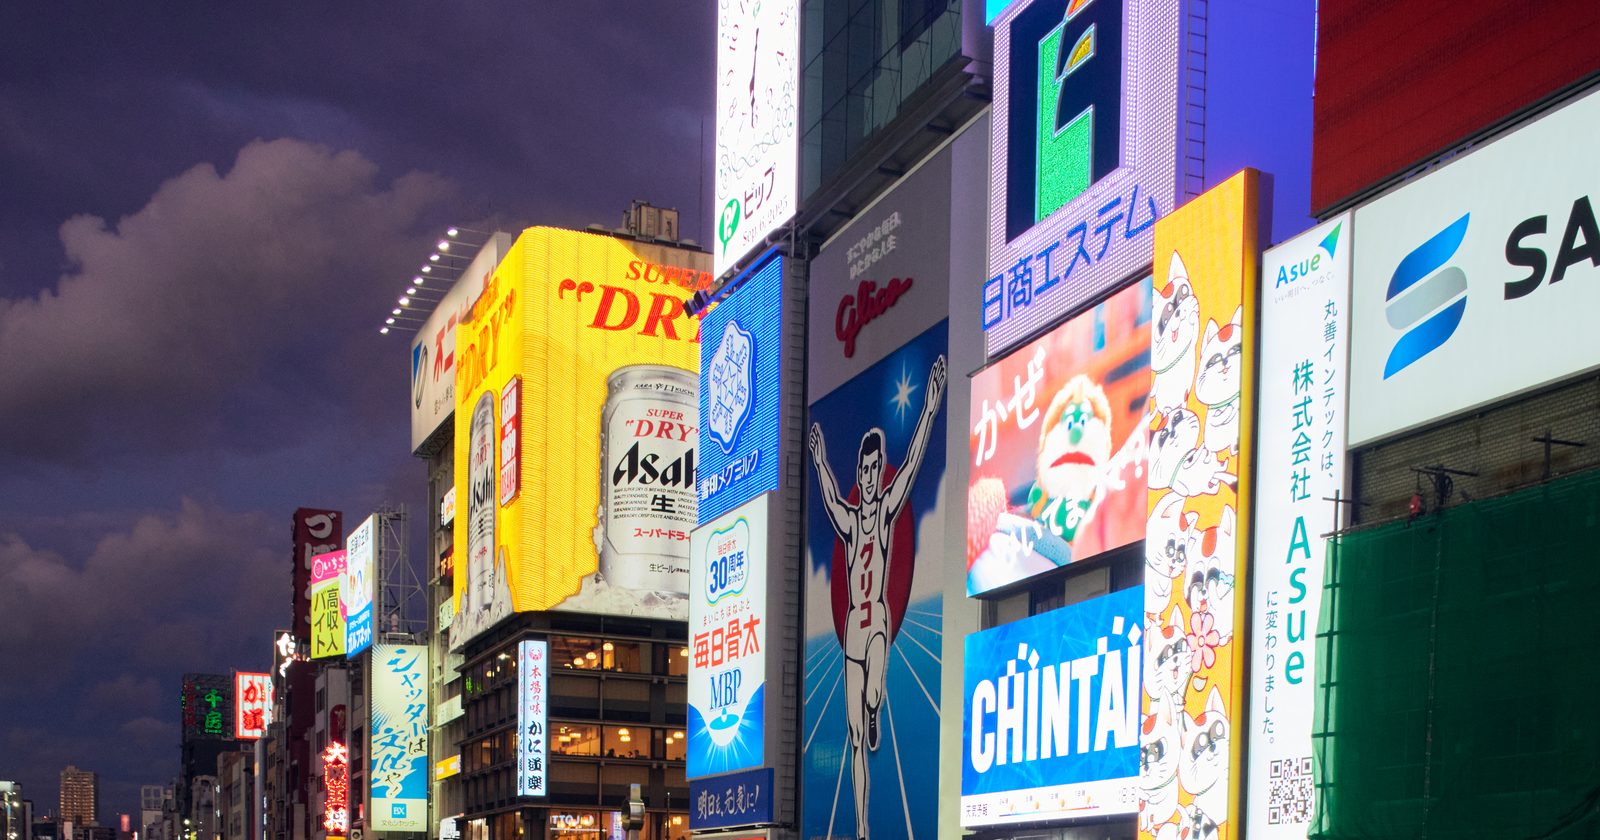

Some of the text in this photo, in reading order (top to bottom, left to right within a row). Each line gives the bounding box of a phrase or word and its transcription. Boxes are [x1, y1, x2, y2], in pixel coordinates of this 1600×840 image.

[982, 184, 1157, 332] 日商エステム
[1276, 254, 1321, 289] Asue
[836, 278, 913, 358] Glico
[646, 408, 684, 421] SUPER
[974, 346, 1047, 468] かぜ
[1320, 299, 1339, 479] 丸善インテックは、
[651, 494, 675, 514] 生
[701, 448, 759, 501] 雪印メグミルク
[709, 550, 744, 594] 30周年
[859, 537, 875, 630] グリコ
[314, 589, 327, 656] バイト
[326, 587, 339, 653] 高収入
[694, 613, 761, 670] 毎日骨太
[529, 664, 542, 716] 本場の味
[710, 667, 742, 710] MBP
[971, 616, 1142, 775] CHINTAI
[1262, 590, 1278, 745] に変わりました。
[393, 806, 405, 816] BX
